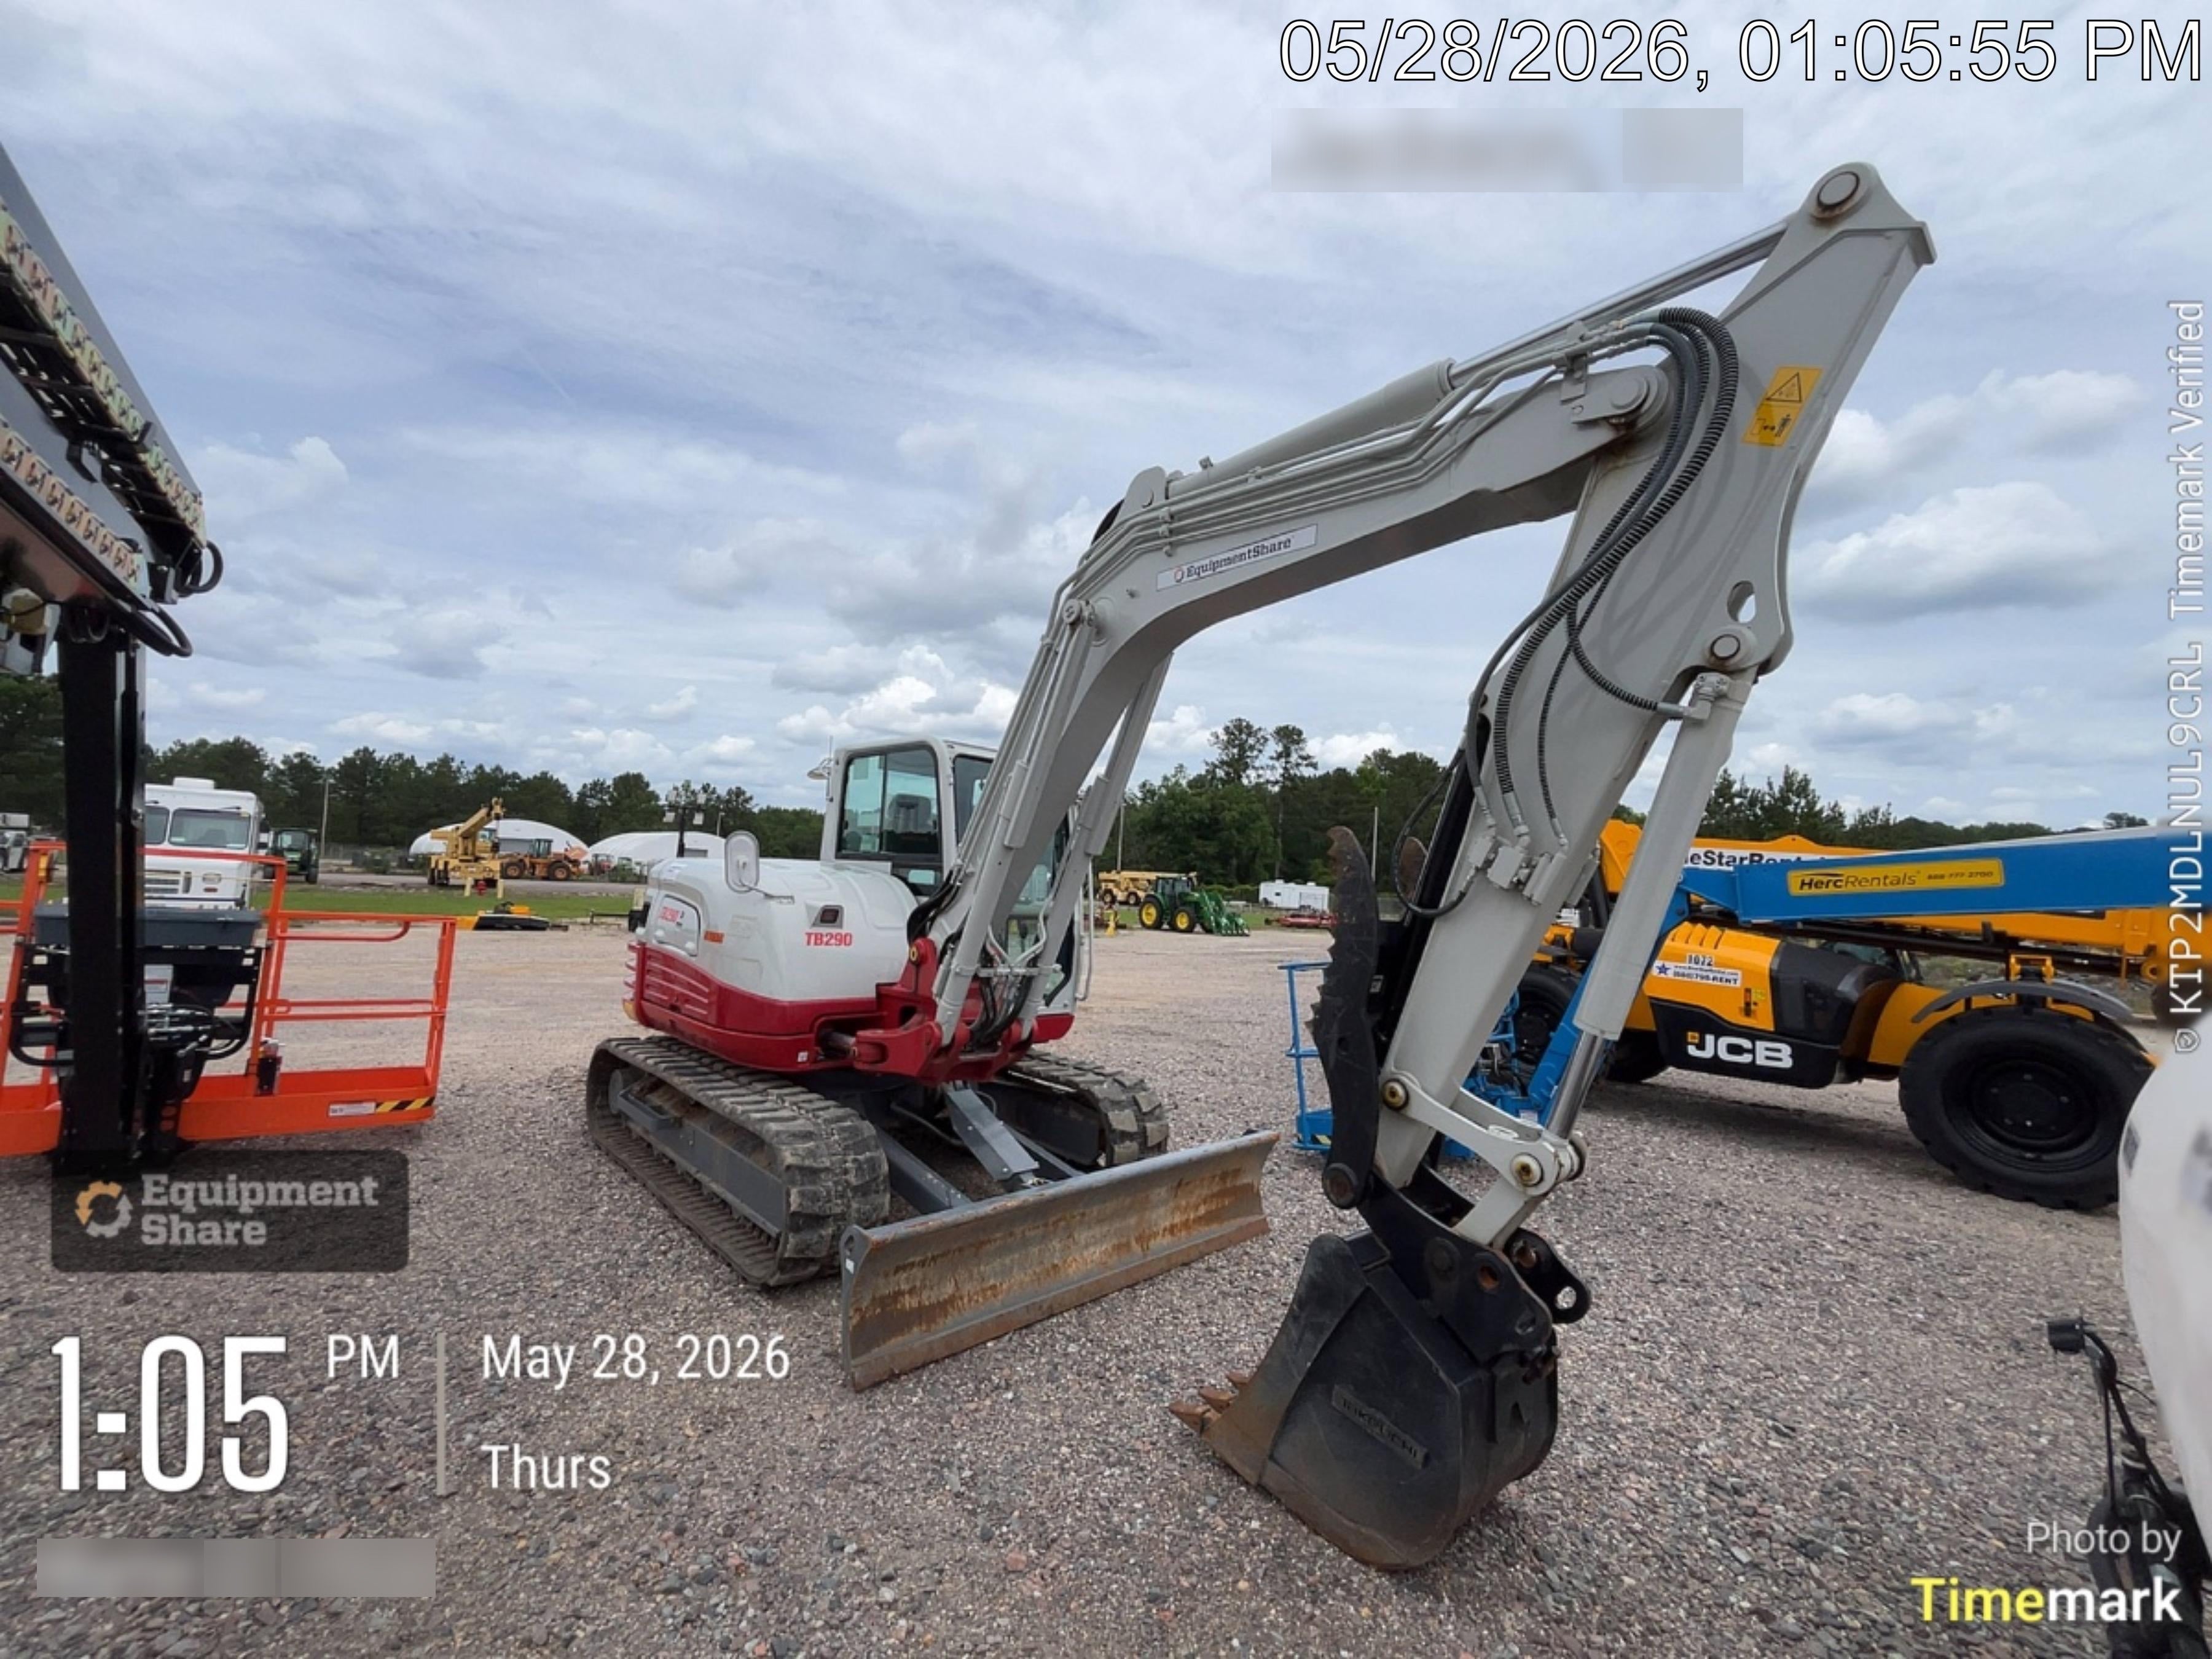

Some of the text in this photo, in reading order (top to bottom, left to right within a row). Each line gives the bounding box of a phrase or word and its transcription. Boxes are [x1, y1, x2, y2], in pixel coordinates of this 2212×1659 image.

[1186, 538, 1292, 578] EquipmentShare
[1799, 872, 1917, 890] HercRentals
[805, 931, 853, 947] TB290
[1687, 1032, 1793, 1069] JCB
